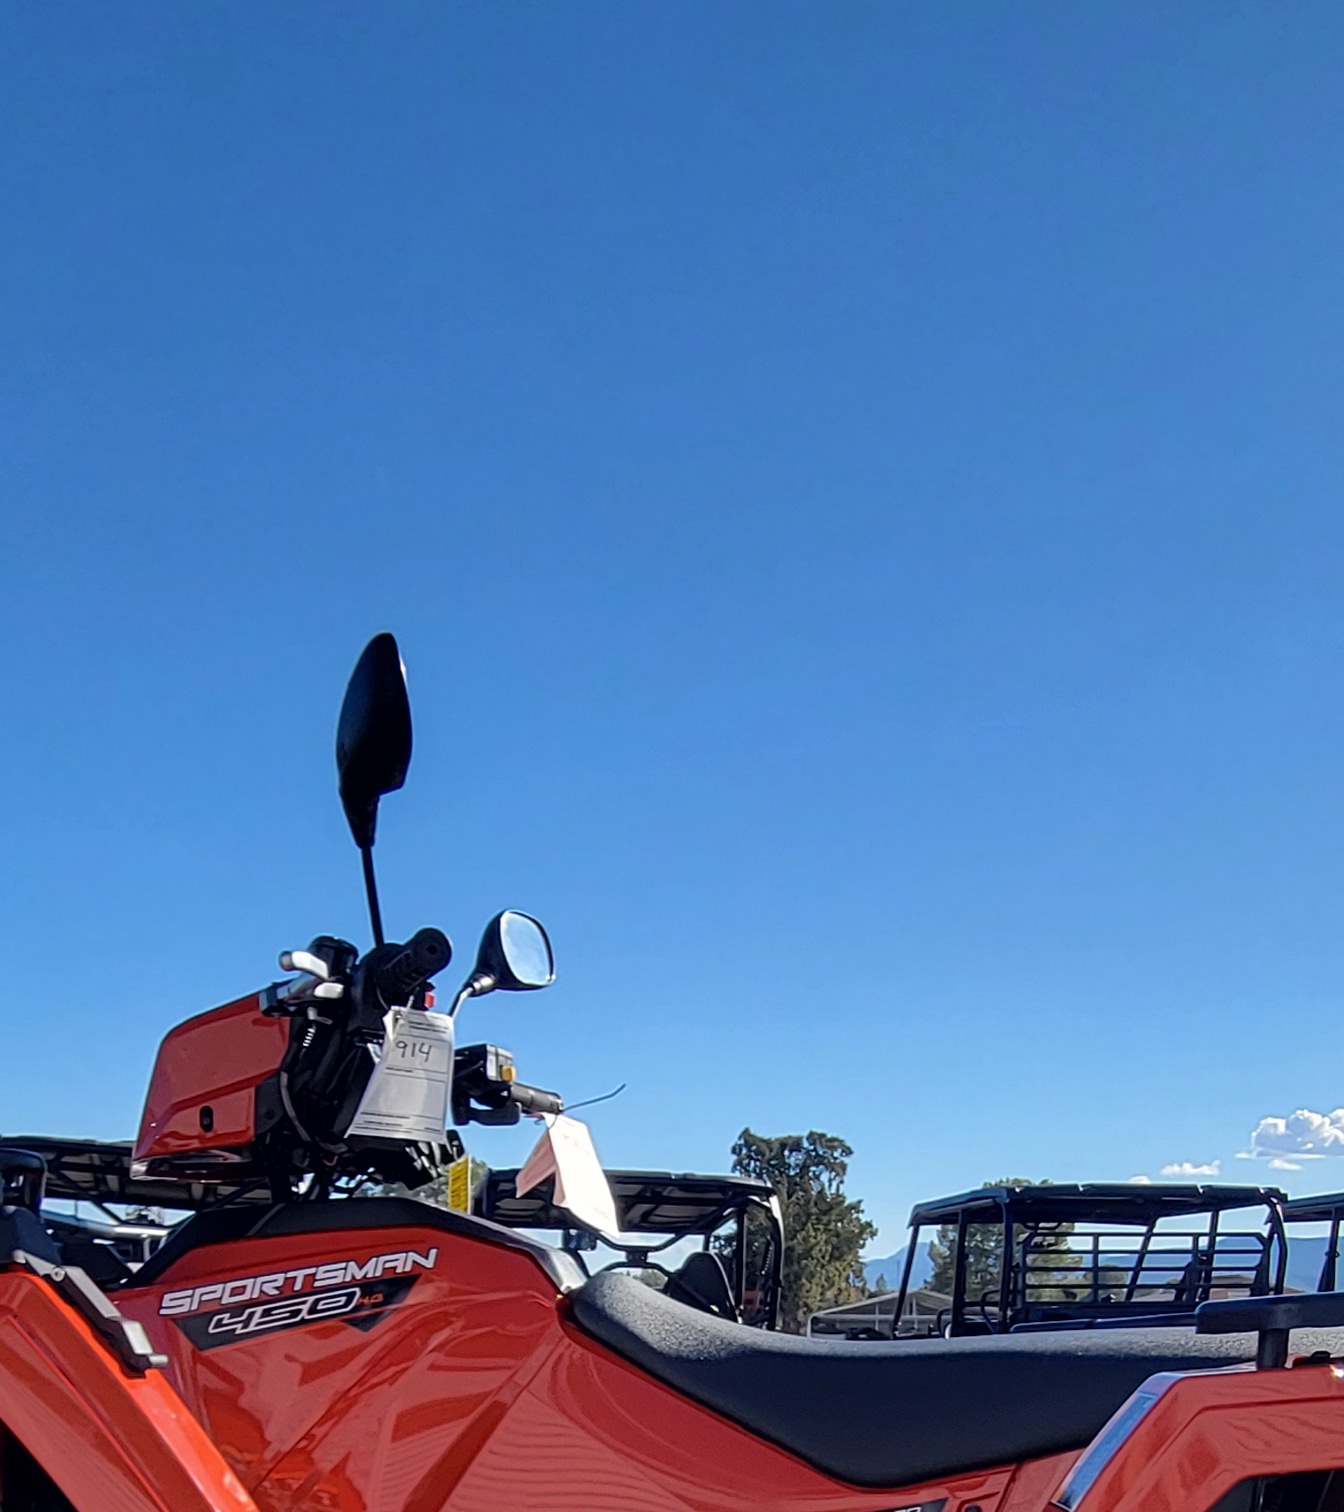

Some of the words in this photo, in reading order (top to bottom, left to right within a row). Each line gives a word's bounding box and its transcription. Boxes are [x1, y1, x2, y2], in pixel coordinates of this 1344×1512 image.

[395, 1040, 432, 1062] 914
[159, 1248, 439, 1315] SPORTSMAN
[208, 1287, 362, 1334] 450
